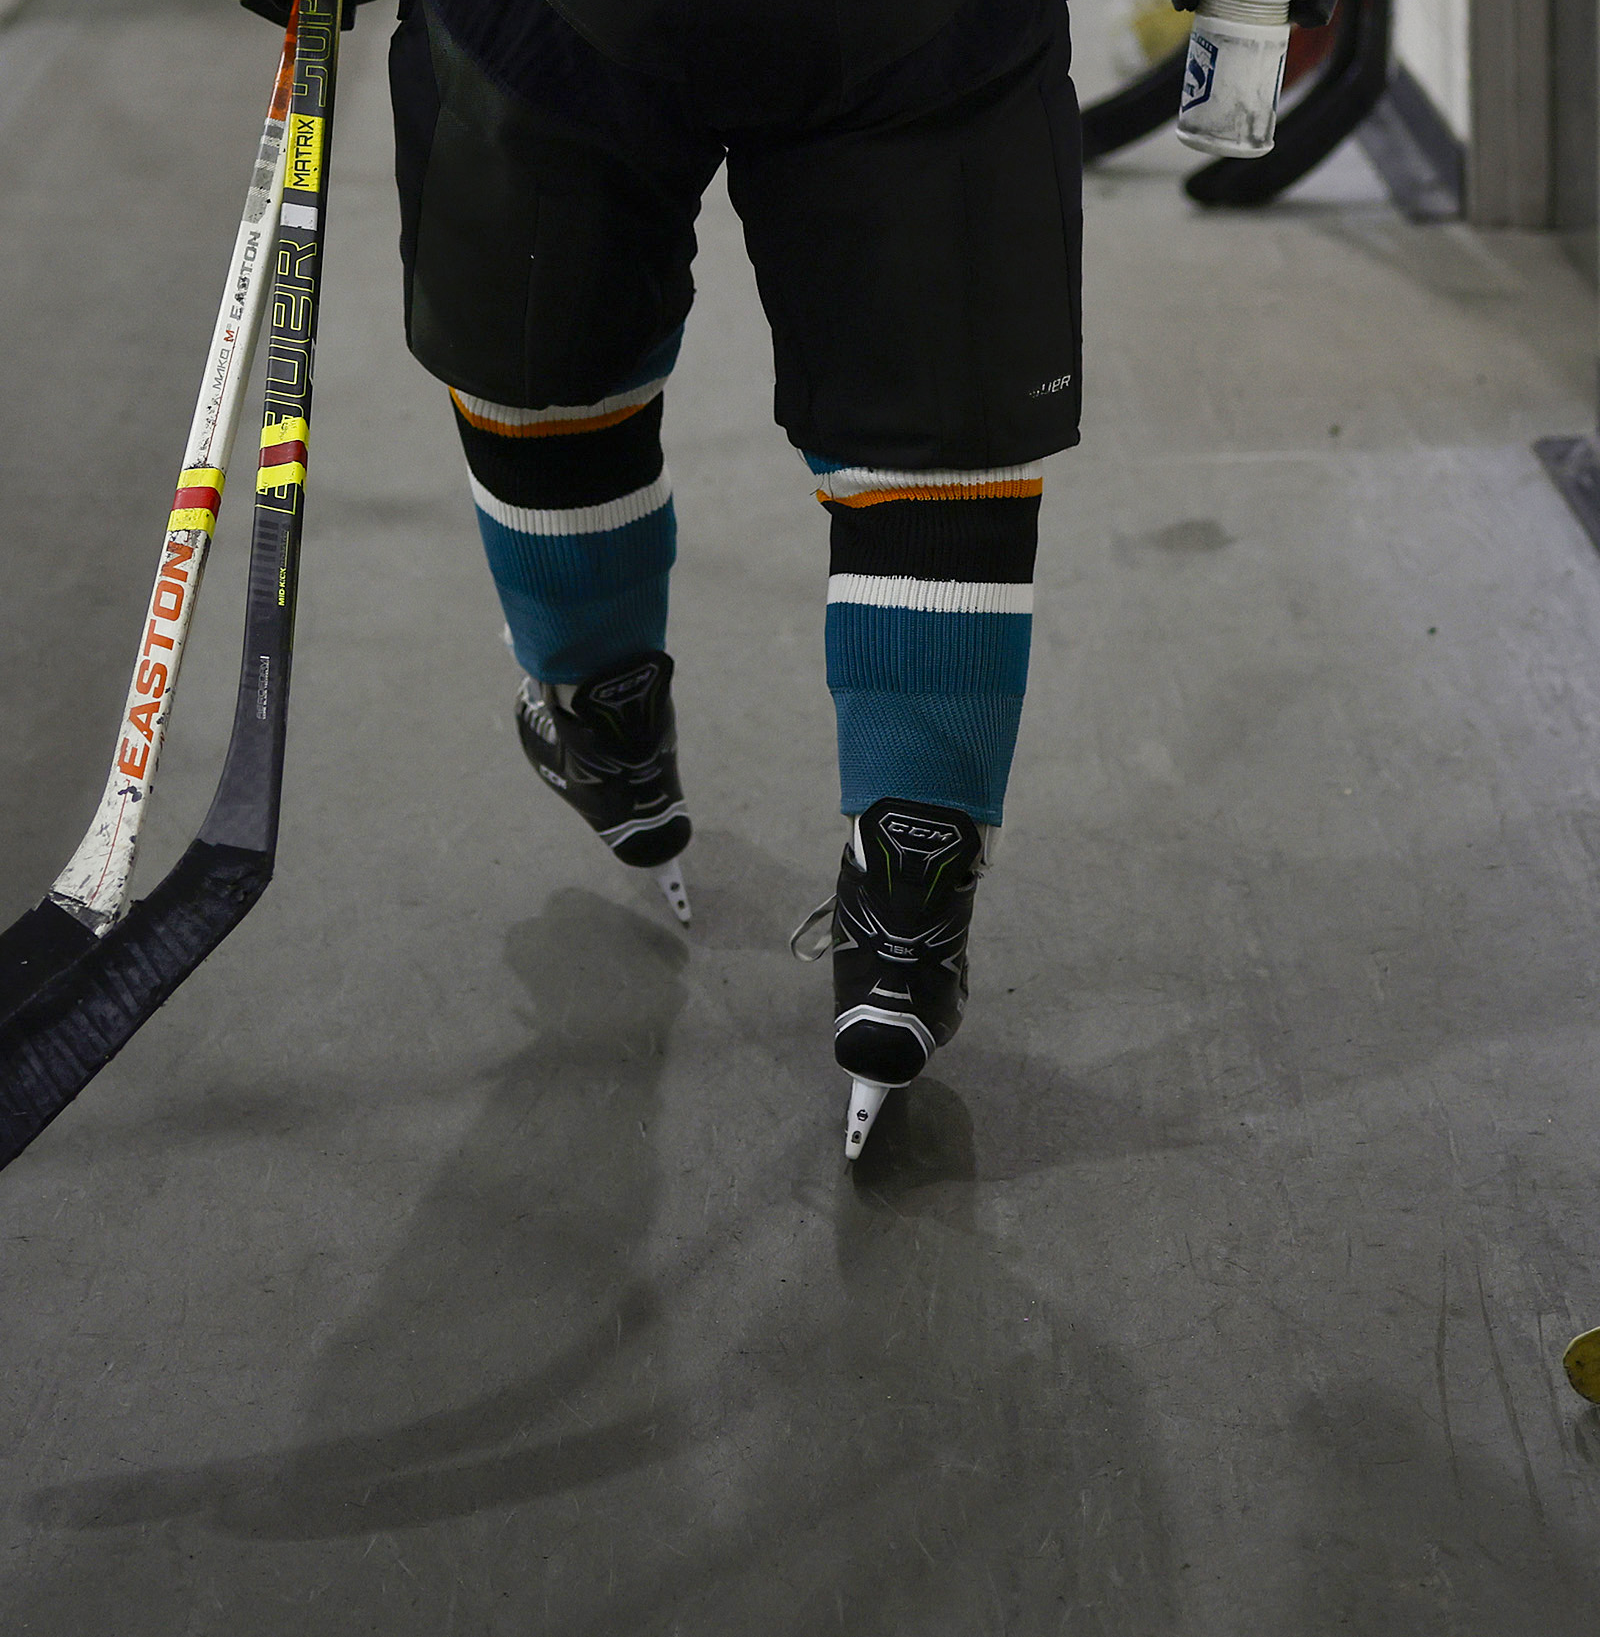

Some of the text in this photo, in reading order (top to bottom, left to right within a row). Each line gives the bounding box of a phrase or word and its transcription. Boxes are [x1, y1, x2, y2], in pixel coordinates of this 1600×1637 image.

[292, 118, 317, 188] MATRIX
[230, 230, 261, 321] EASTON
[212, 348, 231, 390] MAKO
[117, 541, 195, 781] EASTON
[886, 820, 953, 842] CCM
